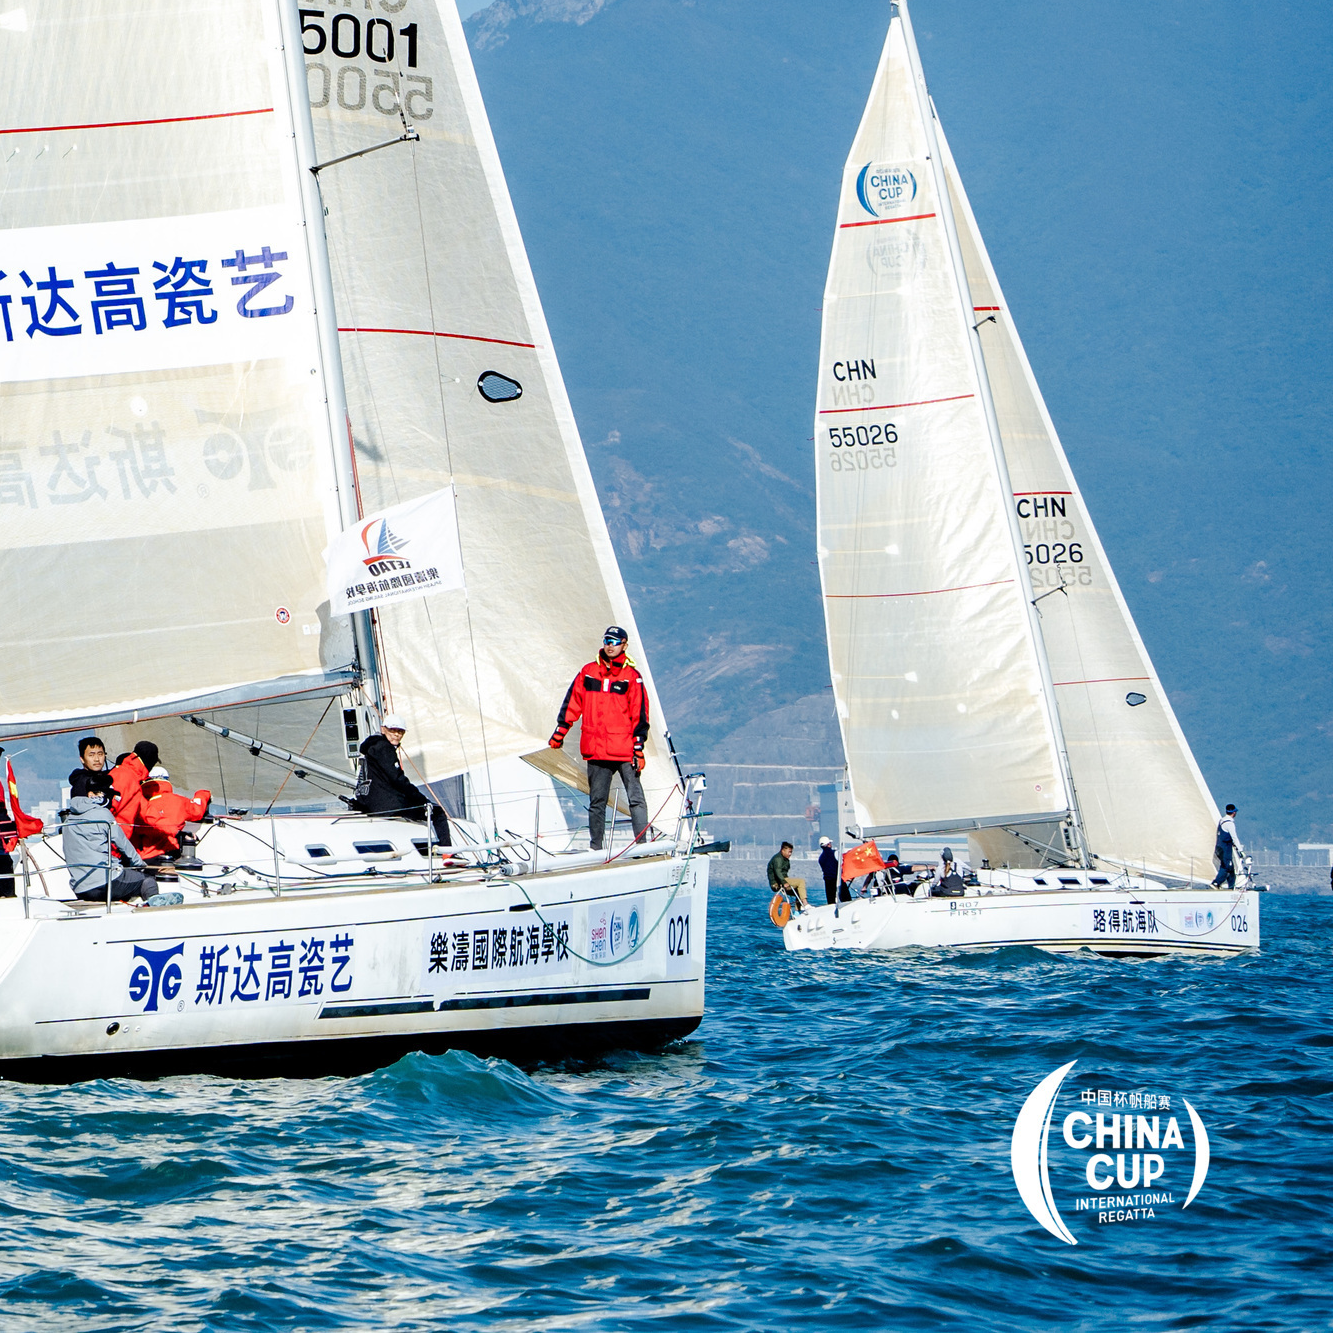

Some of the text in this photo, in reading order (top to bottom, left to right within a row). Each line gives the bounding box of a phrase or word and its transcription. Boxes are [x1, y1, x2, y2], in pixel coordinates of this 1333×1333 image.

[870, 174, 909, 188] CHINA
[878, 187, 903, 200] CUP
[833, 358, 877, 382] CHN
[829, 423, 899, 449] 55026
[1016, 497, 1067, 519] CHN
[1093, 909, 1159, 934] 路得航海队
[1231, 914, 1248, 933] 026
[428, 920, 570, 974] 樂濤國際航海學校
[668, 914, 690, 957] 021
[194, 932, 354, 1006] 斯达高瓷艺
